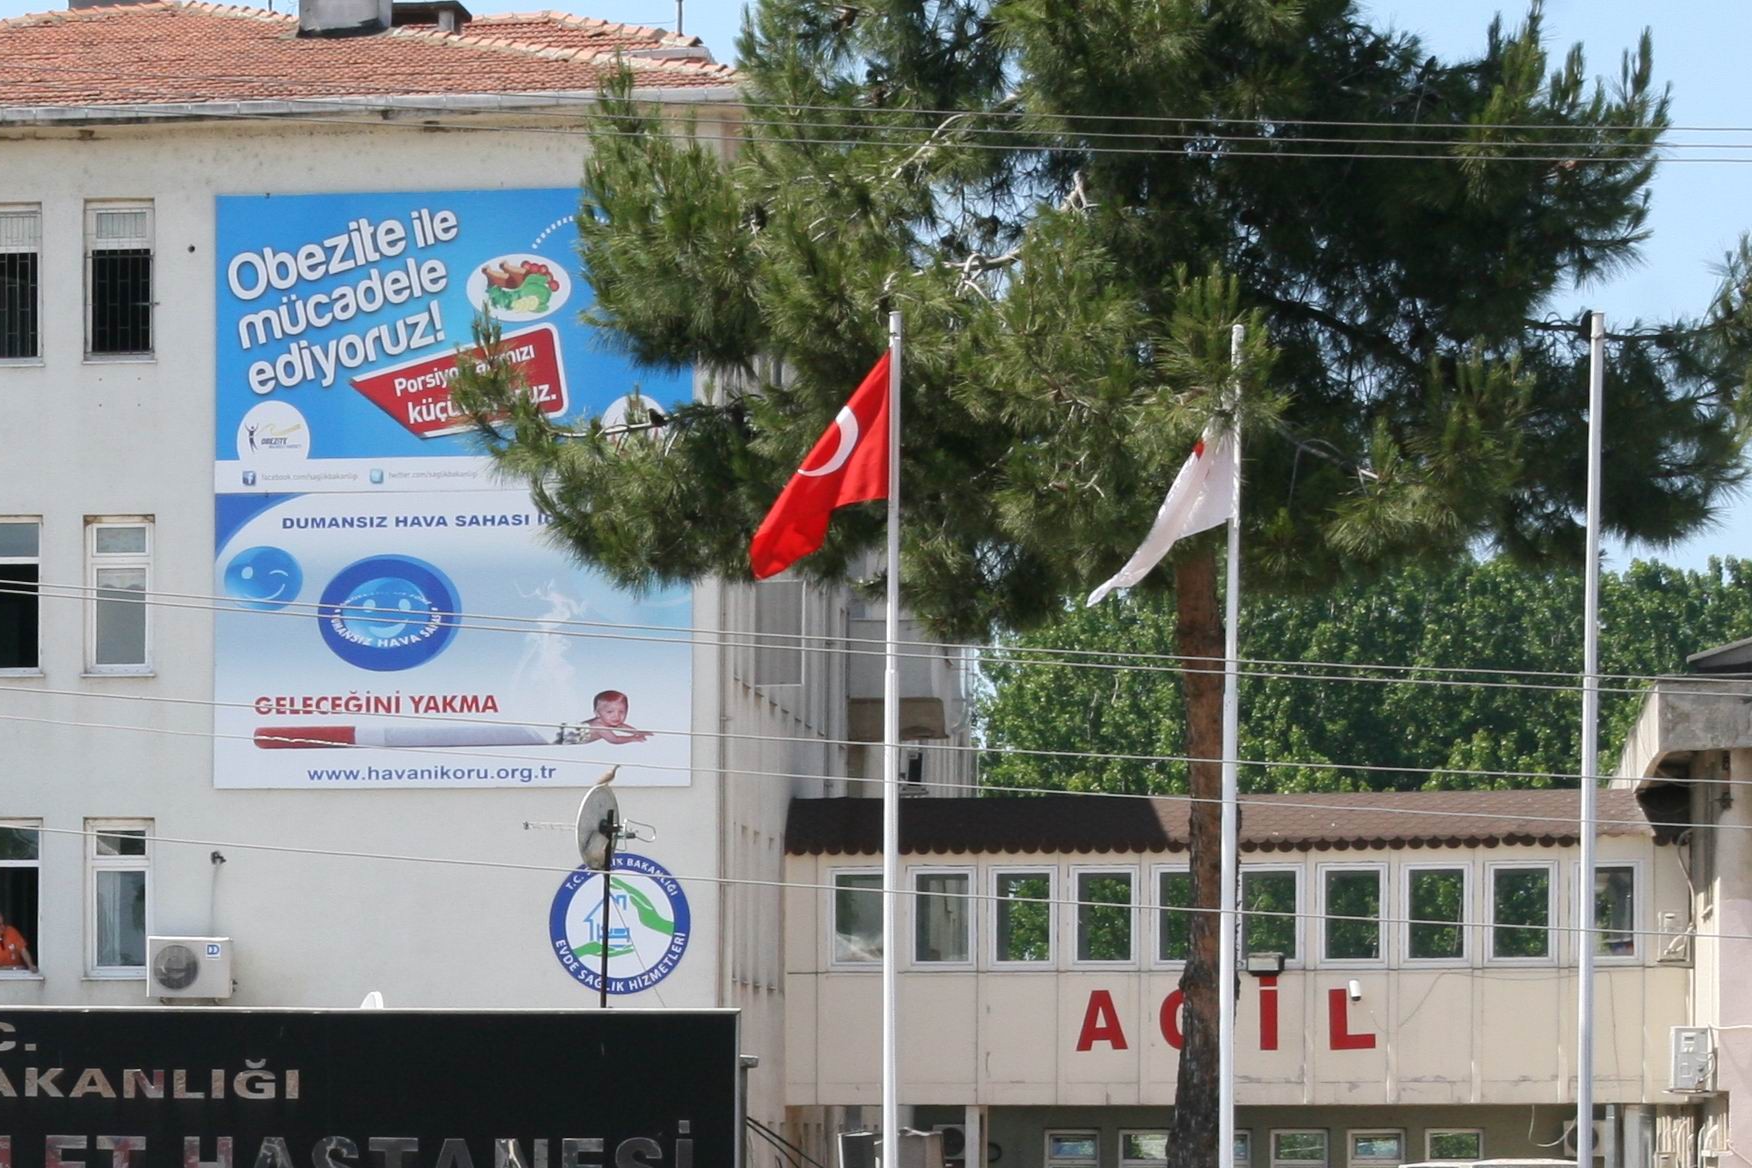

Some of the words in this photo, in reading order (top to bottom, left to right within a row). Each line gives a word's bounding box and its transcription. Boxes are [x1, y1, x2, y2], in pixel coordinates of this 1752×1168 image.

[227, 217, 406, 301] Obezite
[410, 207, 459, 250] ile
[237, 256, 448, 350] mücadele
[247, 299, 446, 395] ediyoruz!
[281, 515, 388, 530] DUMANSIZ
[394, 515, 448, 529] HAVA
[455, 514, 530, 528] SAHASI
[377, 634, 422, 648] HAVA
[254, 690, 401, 716] GELECEĞİNİ
[409, 694, 499, 715] YAKMA
[307, 765, 557, 783] www.havanikoru.org.tr
[565, 875, 585, 890] T.C.
[555, 939, 579, 972] EVDE
